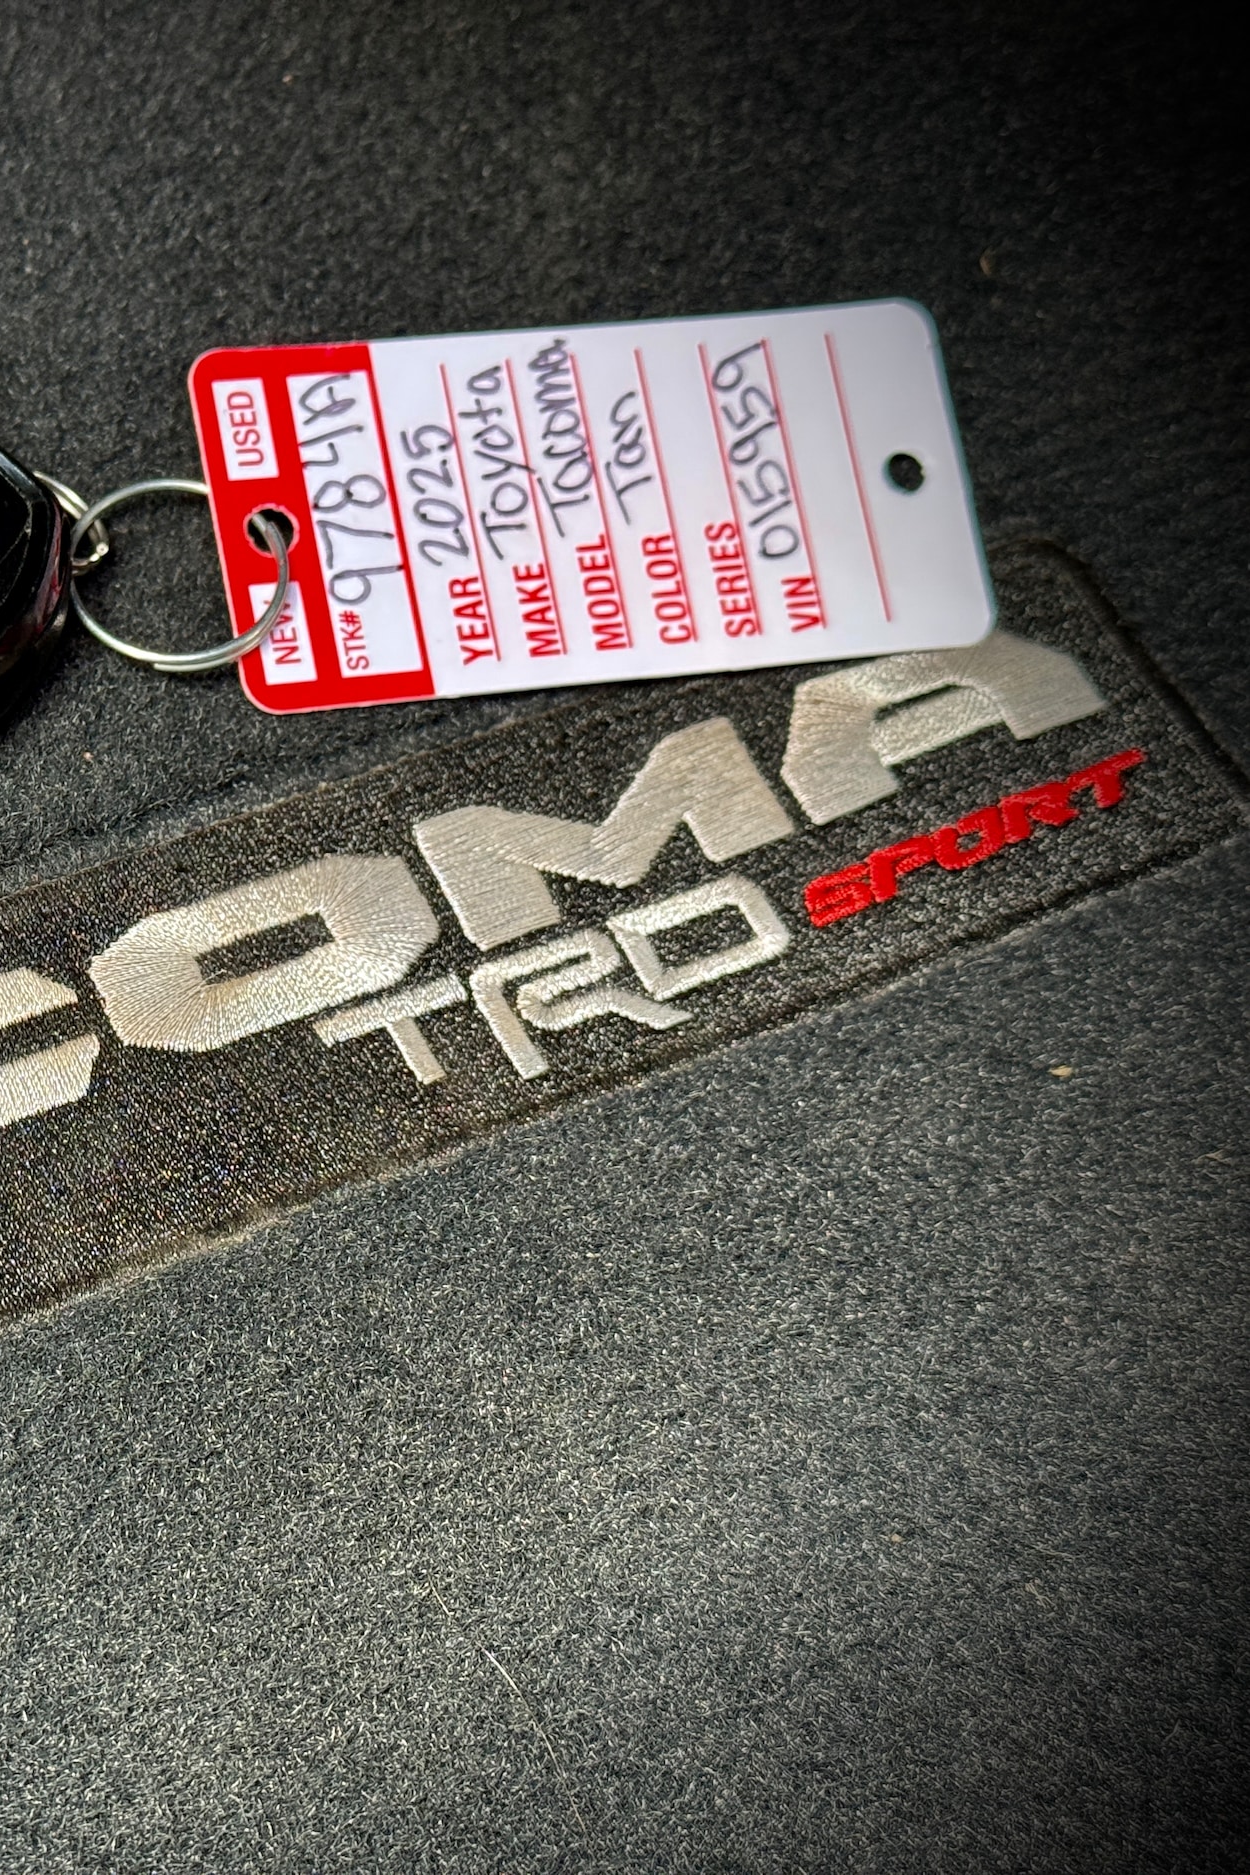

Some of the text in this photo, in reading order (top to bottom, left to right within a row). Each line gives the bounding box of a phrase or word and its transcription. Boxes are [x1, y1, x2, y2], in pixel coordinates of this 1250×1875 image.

[227, 390, 265, 468] USED
[458, 364, 536, 560] Toyota
[527, 337, 596, 538] Tacoma
[605, 390, 654, 526] Tan
[710, 340, 801, 561] 015959
[401, 423, 470, 567] 2025
[448, 575, 494, 666] YEAR
[512, 562, 565, 659] MAKE
[575, 533, 628, 652] MODEL
[641, 533, 693, 645] COLOR
[703, 520, 758, 639] SERIES
[780, 575, 822, 634] VIN
[338, 609, 370, 671] STK#
[315, 748, 1146, 1086] TRD SPORT
